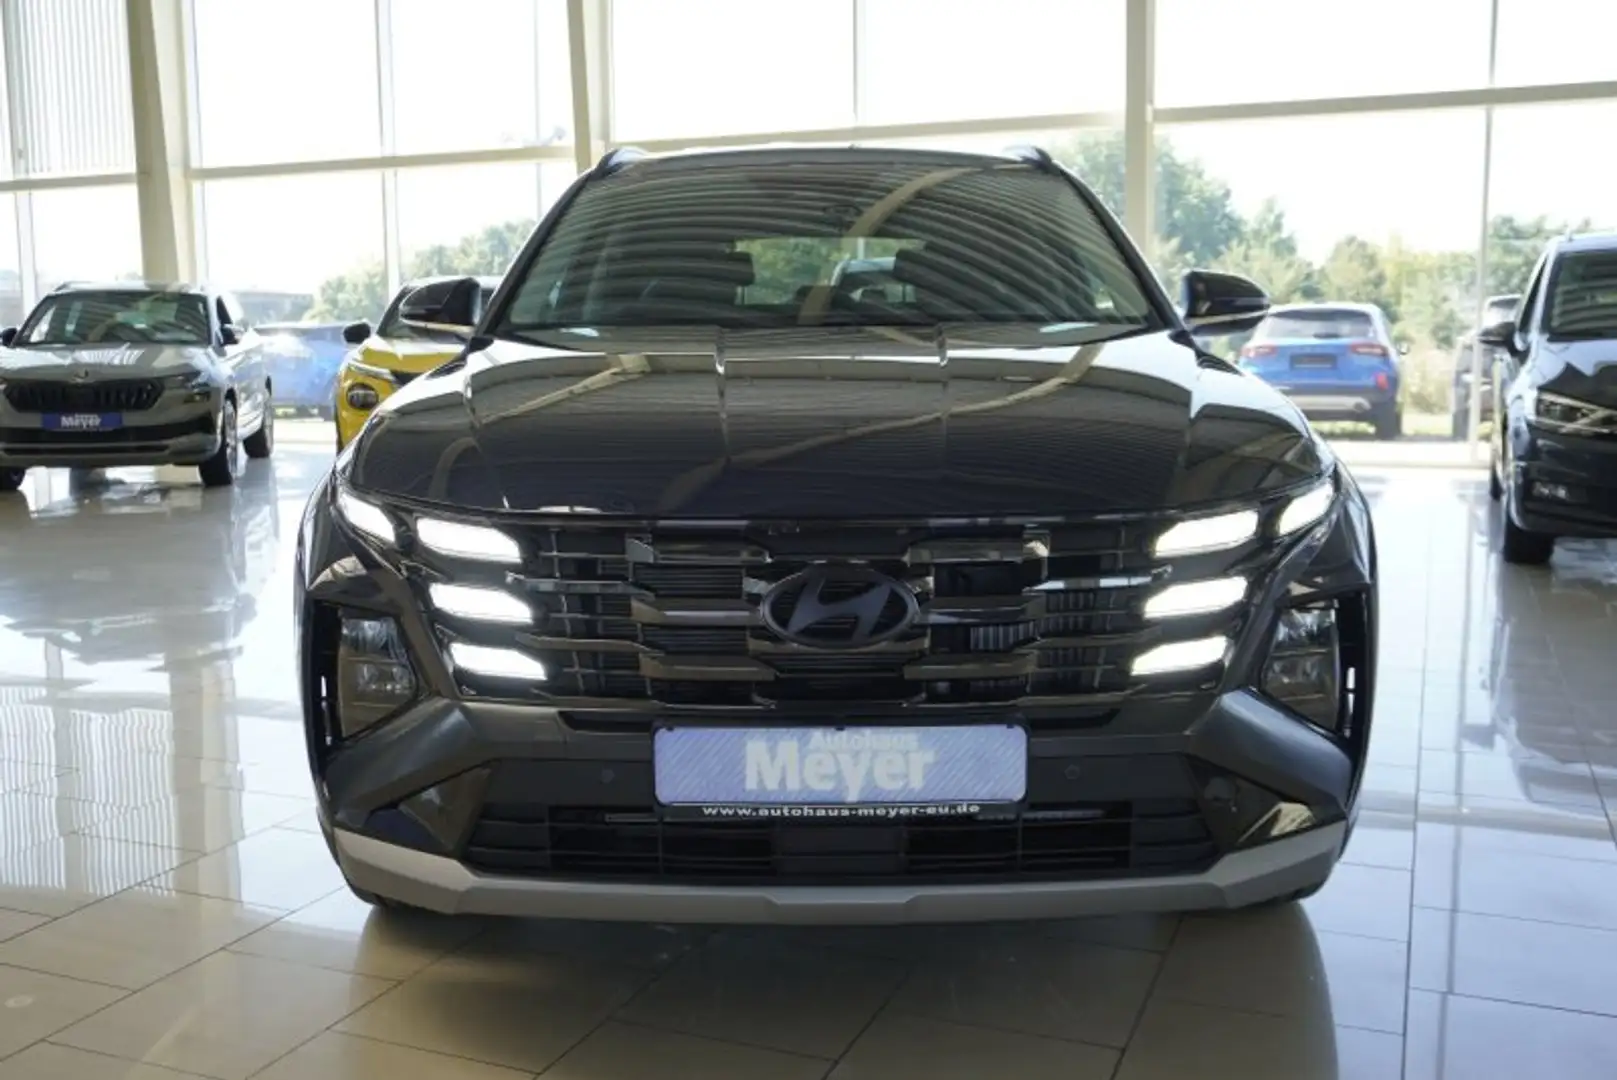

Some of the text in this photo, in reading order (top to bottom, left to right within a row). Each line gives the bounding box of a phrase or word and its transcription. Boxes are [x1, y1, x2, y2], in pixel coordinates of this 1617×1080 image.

[809, 730, 919, 750] Autohaus
[744, 739, 935, 803] Meyer
[702, 804, 980, 818] www.autohaus-meyer-eu.de
